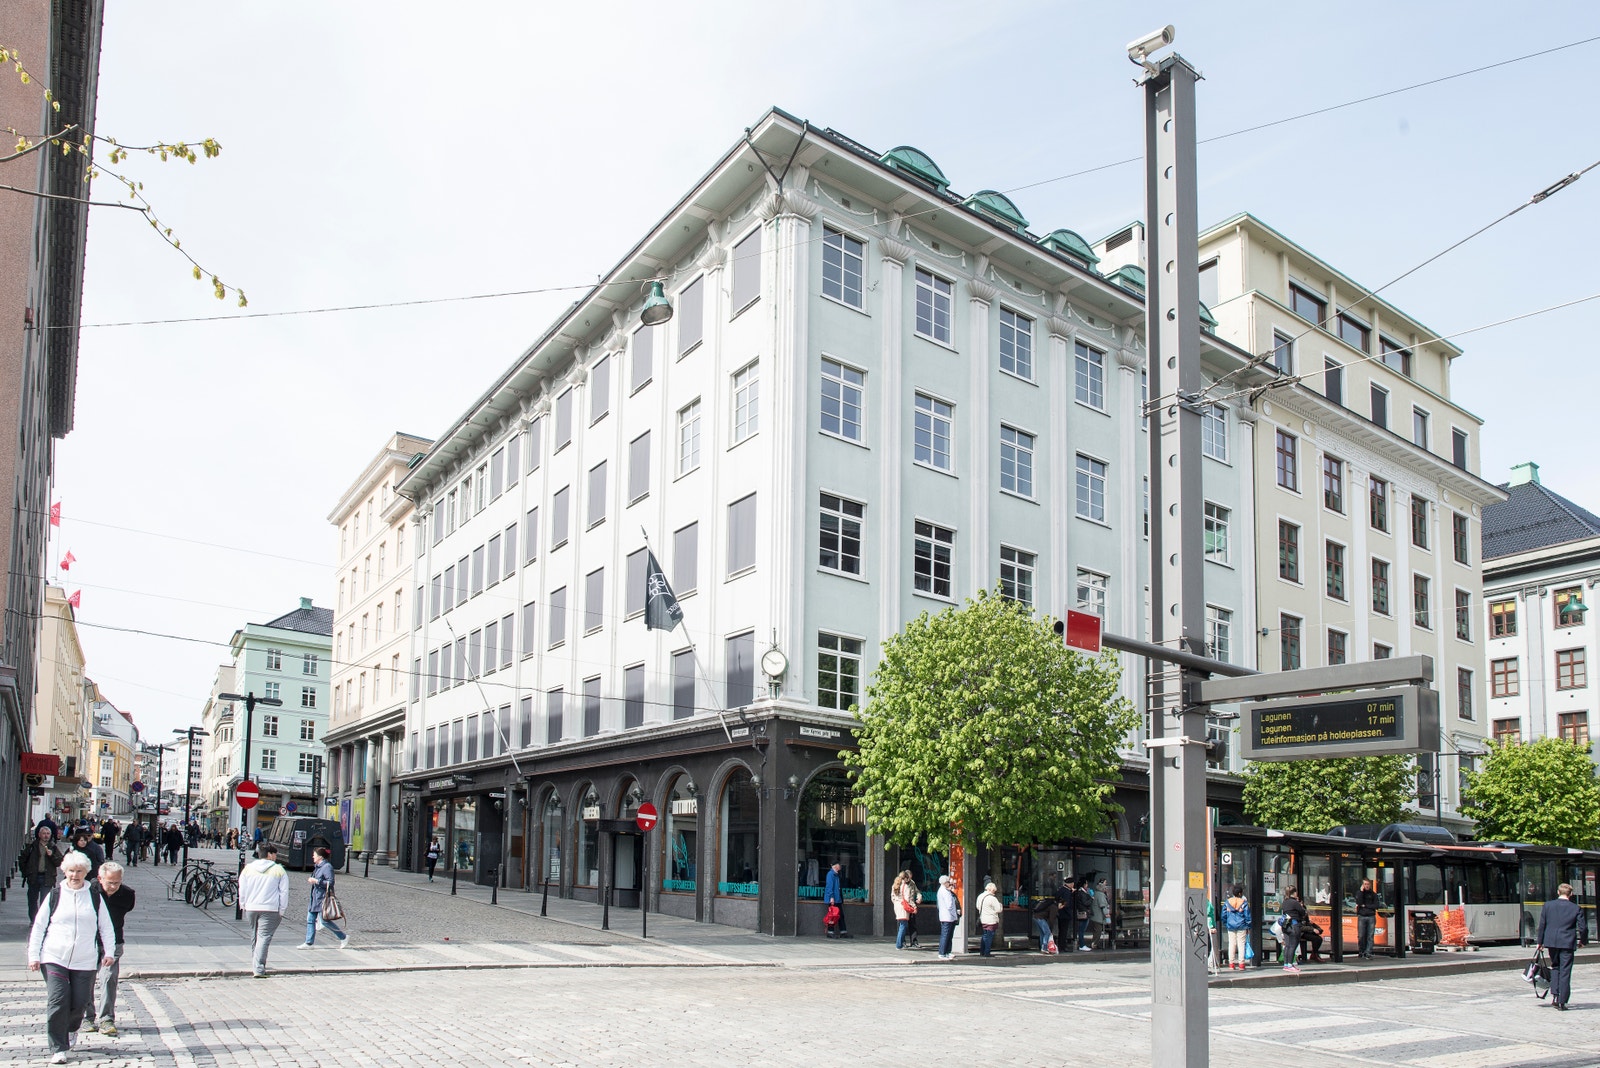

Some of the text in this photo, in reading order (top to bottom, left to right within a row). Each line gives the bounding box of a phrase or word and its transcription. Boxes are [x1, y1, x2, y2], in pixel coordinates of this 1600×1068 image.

[1261, 702, 1395, 723] Lagunen 07 min
[1261, 715, 1395, 734] Lagunen 17 min
[1261, 728, 1385, 745] ruteinformasjon på holdeplassen.
[1058, 862, 1063, 870] D
[1223, 854, 1230, 863] C
